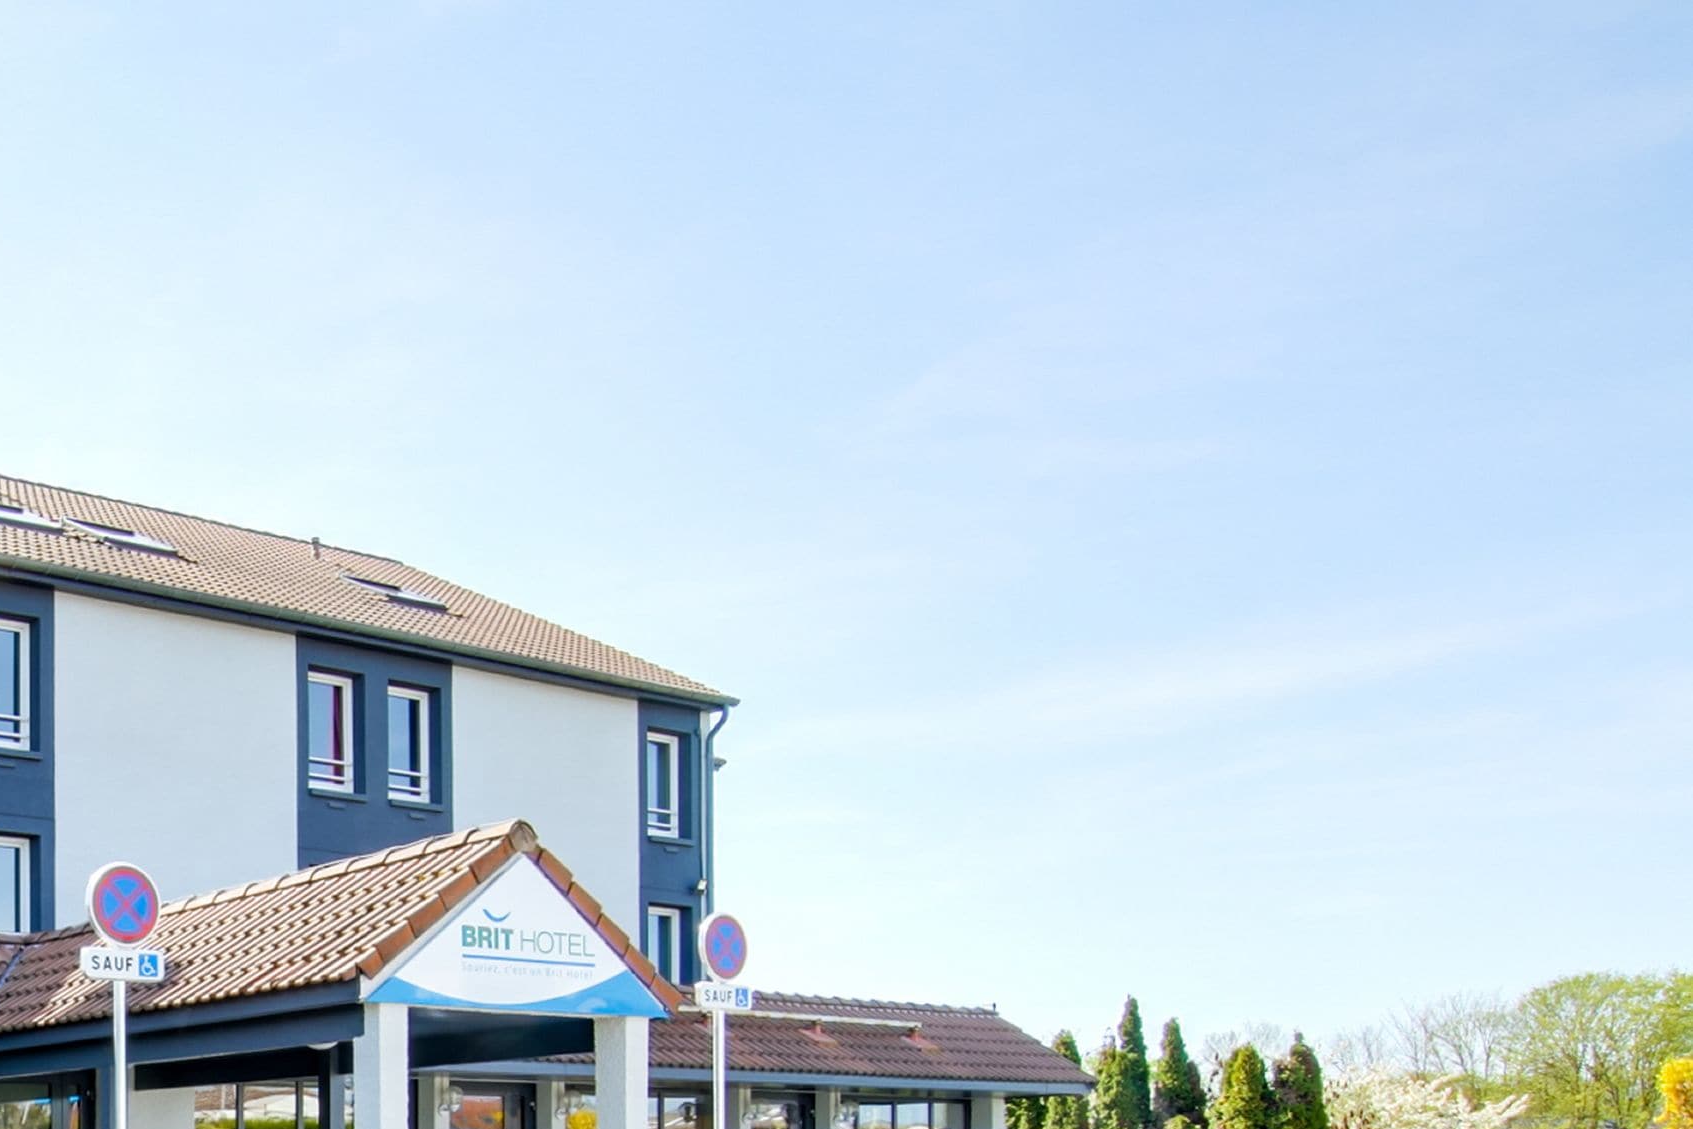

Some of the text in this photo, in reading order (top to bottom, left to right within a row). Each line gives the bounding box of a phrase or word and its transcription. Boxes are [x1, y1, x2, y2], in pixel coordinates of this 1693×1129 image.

[461, 924, 595, 957] BRIT HOTEL
[91, 955, 133, 971] SAUF
[704, 989, 732, 1002] SAUF
